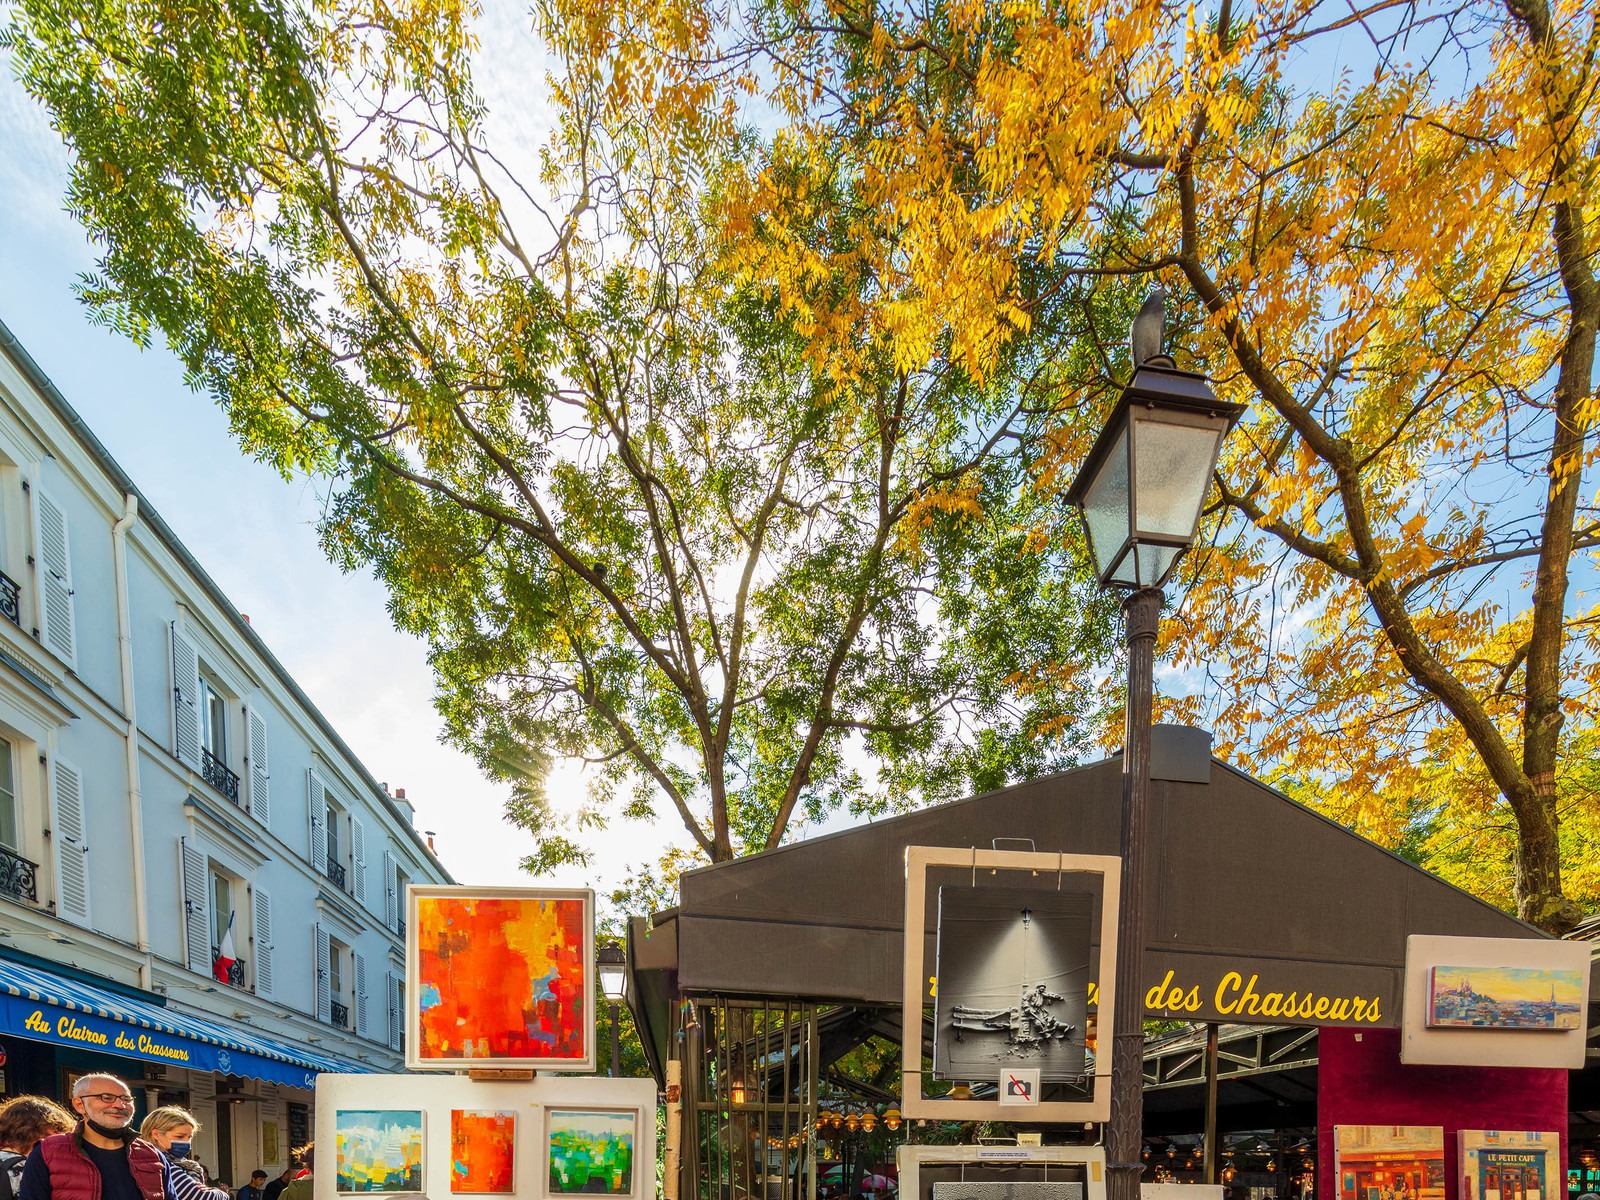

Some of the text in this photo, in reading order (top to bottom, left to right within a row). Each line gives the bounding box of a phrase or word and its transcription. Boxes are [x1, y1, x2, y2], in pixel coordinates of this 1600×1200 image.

[1145, 969, 1203, 1011] des
[1214, 971, 1381, 1022] Chasseurs
[24, 1010, 52, 1034] Au
[57, 1016, 109, 1046] Clairon
[114, 1030, 137, 1051] des
[138, 1034, 189, 1062] Chasseurs
[304, 1073, 315, 1088] Caf
[1487, 1153, 1497, 1162] LE
[1498, 1154, 1517, 1162] PETIT
